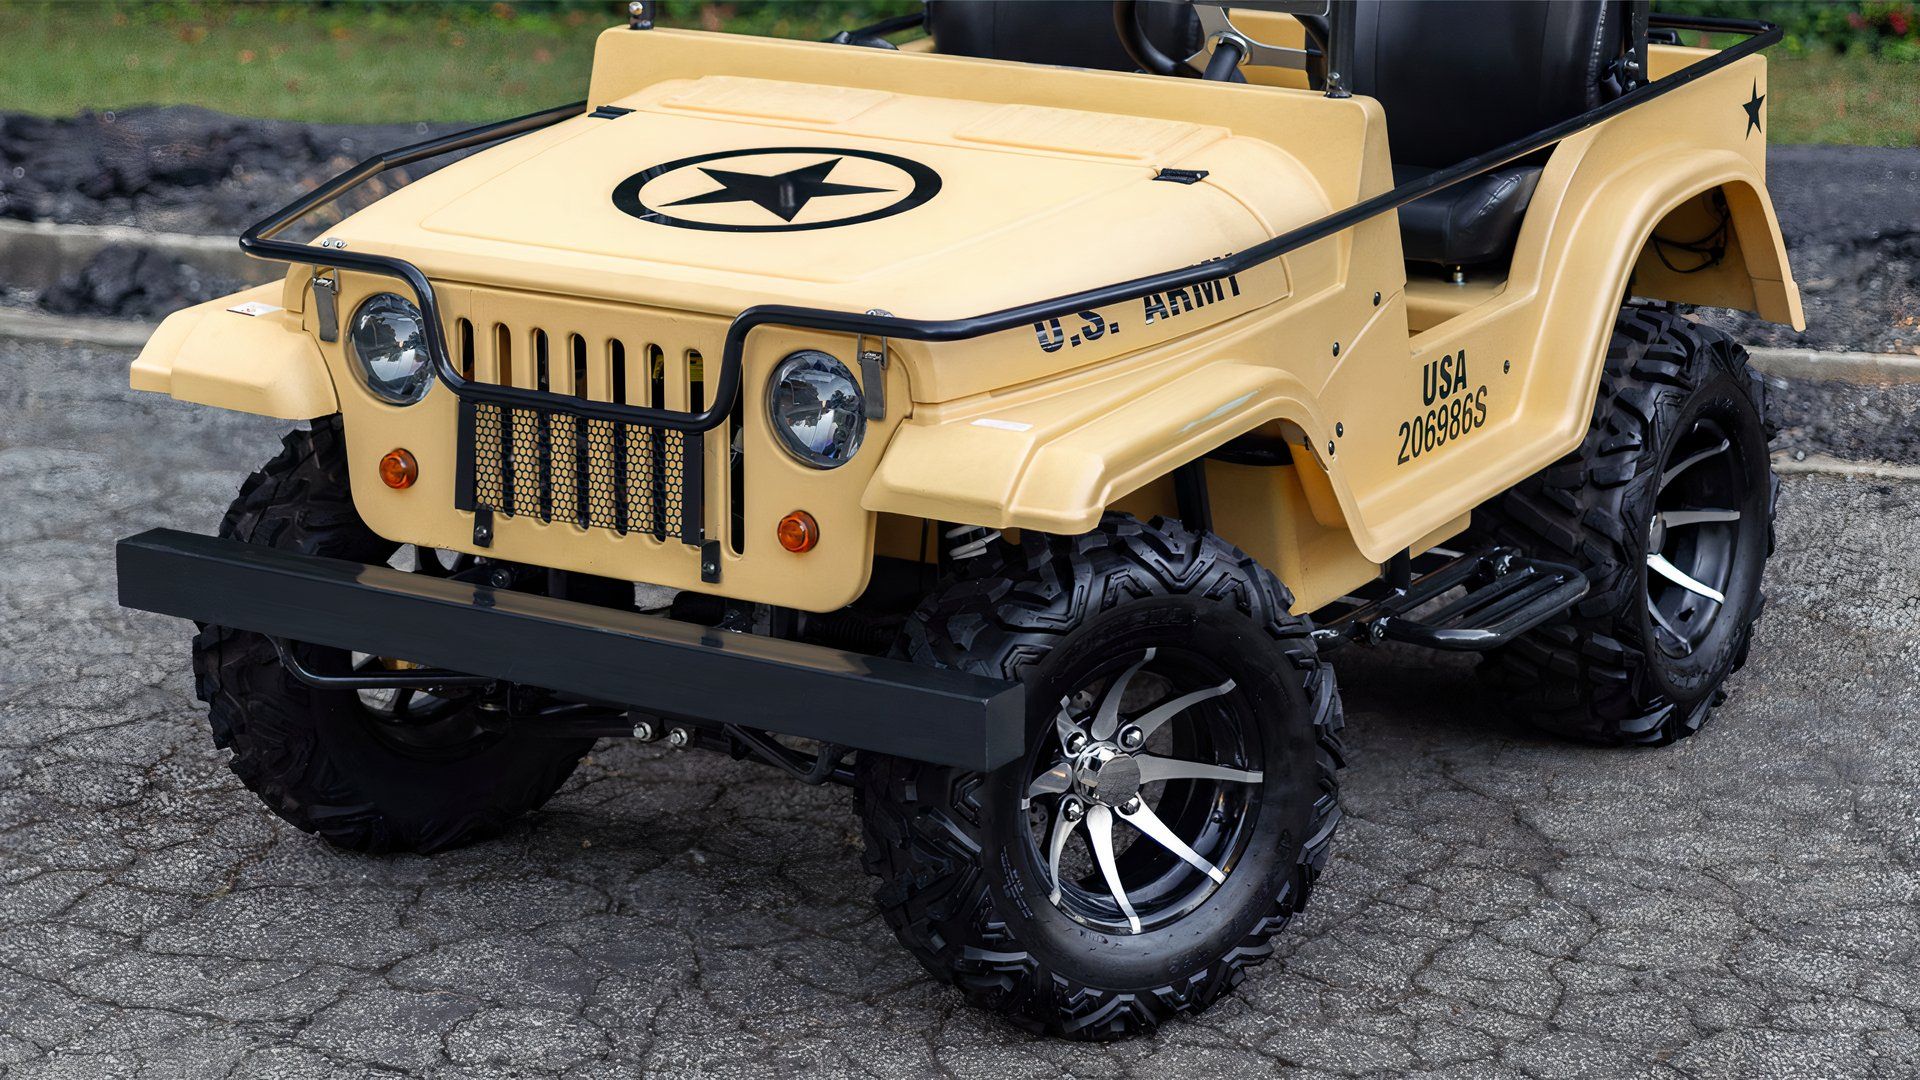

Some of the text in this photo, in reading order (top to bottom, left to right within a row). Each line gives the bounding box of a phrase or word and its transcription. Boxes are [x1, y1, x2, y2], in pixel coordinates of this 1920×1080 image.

[1033, 309, 1120, 353] U.S.
[1422, 349, 1467, 407] USA
[1397, 385, 1488, 466] 206986S
